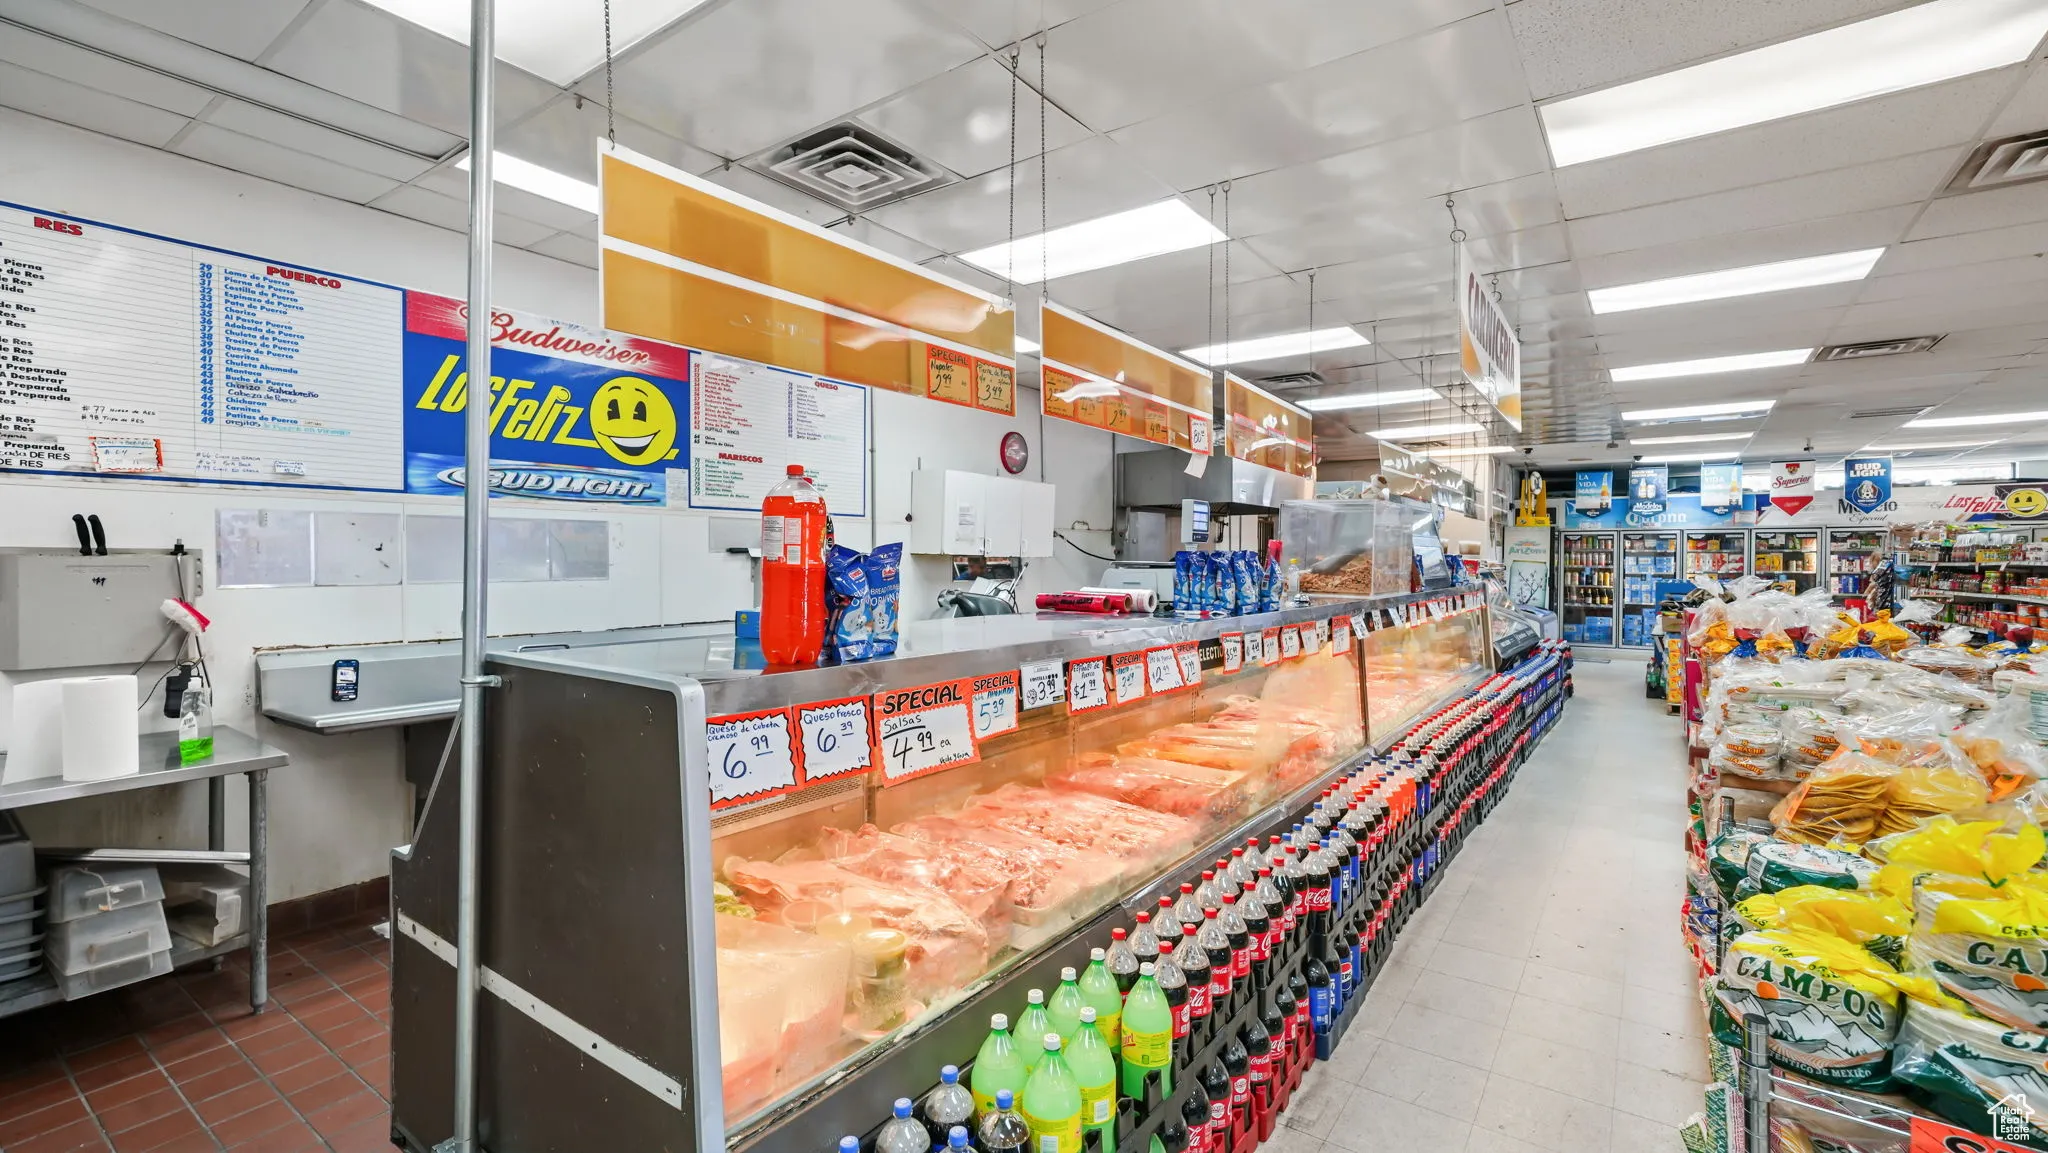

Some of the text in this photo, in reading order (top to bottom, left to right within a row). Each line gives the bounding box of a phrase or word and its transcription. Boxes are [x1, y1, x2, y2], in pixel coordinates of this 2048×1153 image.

[34, 216, 83, 236] RES
[4, 258, 43, 271] Pierna
[6, 268, 46, 280] de Res
[200, 271, 212, 279] 30
[225, 268, 247, 278] Lomo
[263, 277, 290, 287] Puerco
[266, 265, 342, 290] PUERCO
[12, 277, 33, 287] Res
[225, 276, 252, 286] Pierna
[268, 285, 295, 295] Puerco
[200, 294, 212, 302] 33
[225, 284, 256, 294] Costilla
[271, 293, 298, 303] Puerco
[225, 292, 262, 303] Espinazo
[278, 301, 304, 311] Puerco
[225, 299, 245, 308] Pata
[260, 305, 287, 315] Puerco
[15, 303, 37, 313] Res
[225, 307, 256, 317] Chorizo
[5, 319, 27, 329] Res
[200, 317, 213, 325] 36
[236, 316, 263, 325] Pastor
[266, 321, 292, 330] Puerco
[225, 322, 263, 332] Adobada
[278, 330, 305, 340] Puerco
[1468, 271, 1515, 388] CARNICERIA
[200, 332, 213, 340] 38
[225, 330, 257, 338] Chuleta
[272, 336, 299, 345] Puerco
[489, 311, 653, 366] Budweiser
[12, 338, 33, 347] Res
[200, 340, 213, 348] 39
[273, 344, 300, 353] Puerco
[13, 346, 34, 355] Res
[226, 345, 251, 353] Queso
[267, 350, 294, 359] Puerco
[226, 352, 260, 361] Cueritos
[931, 347, 970, 366] SPECIAL
[11, 355, 32, 363] Res
[6, 363, 67, 377] Preparada
[226, 360, 299, 374] Chuleta Ahumada
[226, 367, 262, 377] Manteca
[10, 372, 65, 385] Desebrar
[226, 375, 251, 383] Buche
[266, 379, 293, 388] Puerco
[6, 381, 68, 393] Preparada
[814, 381, 839, 391] QUESO
[10, 390, 71, 402] Preparada
[201, 393, 213, 401] 46
[226, 397, 267, 407] Chicharon
[226, 405, 261, 413] Carnitas
[15, 416, 36, 424] Res
[201, 416, 214, 424] 49
[226, 412, 256, 420] Patitas
[272, 417, 299, 425] Puerco
[13, 424, 34, 432] Res
[4, 441, 66, 452] Preparada
[29, 451, 45, 459] DE
[47, 453, 71, 461] RES
[718, 452, 763, 464] MARISCOS
[20, 460, 44, 468] RES
[1854, 462, 1882, 470] BUD
[1849, 468, 1887, 477] LIGHT
[555, 475, 652, 498] LIGHT
[1772, 475, 1813, 489] Superior
[973, 674, 1014, 692] SPECIAL
[882, 683, 962, 715] SPECIAL
[803, 711, 836, 725] Queso
[884, 714, 922, 734] Salsas
[708, 721, 781, 735] Queso de Cubeta
[940, 738, 951, 748] ea
[1737, 956, 1886, 1031] CAMPOS
